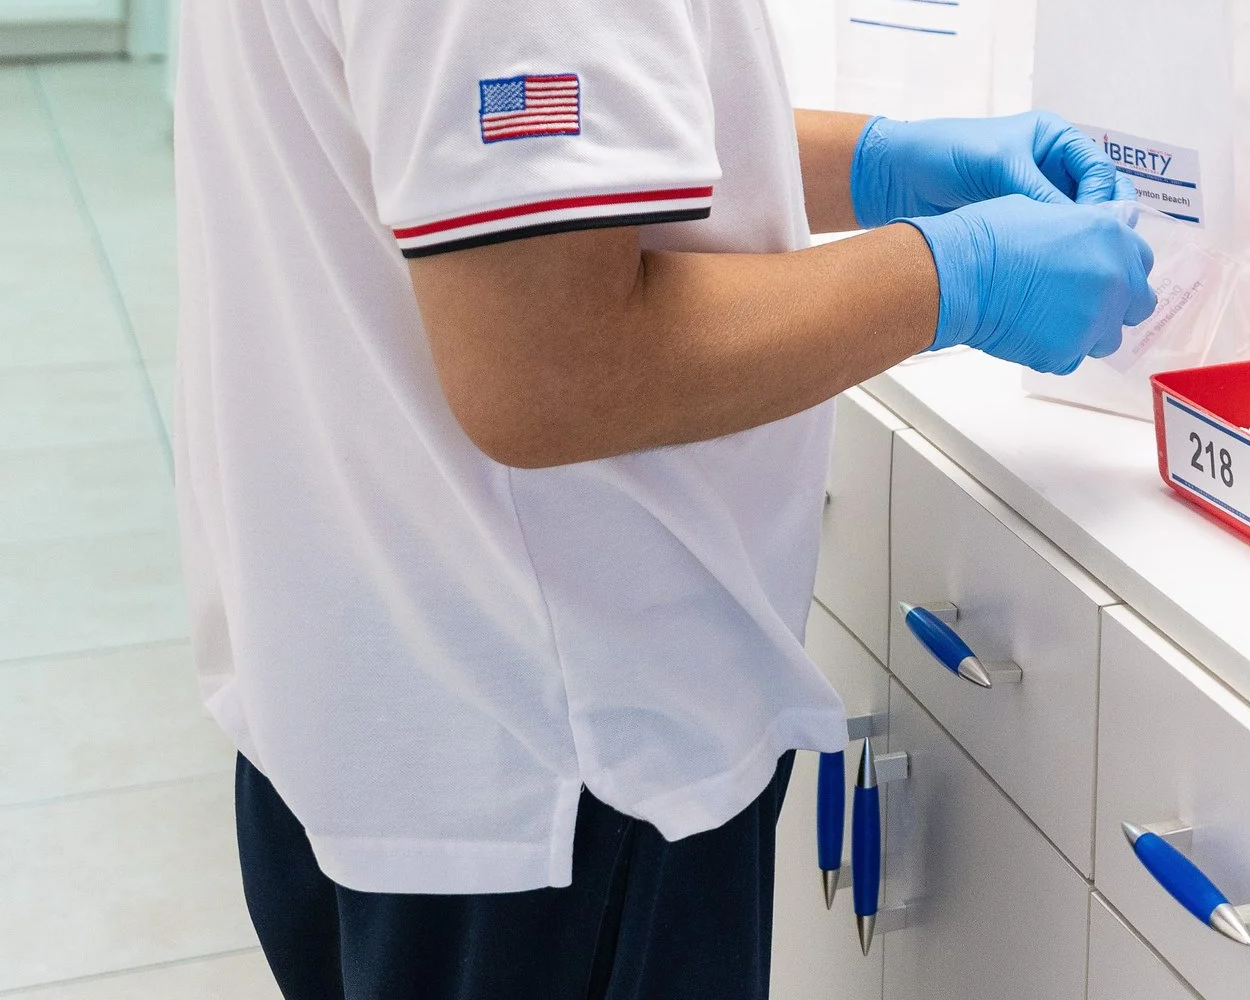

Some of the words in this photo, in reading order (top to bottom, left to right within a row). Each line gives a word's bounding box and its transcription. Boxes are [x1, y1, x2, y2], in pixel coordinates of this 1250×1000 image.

[1092, 138, 1172, 176] IBERTY
[1162, 191, 1191, 207] Beach)
[1189, 431, 1234, 488] 218
